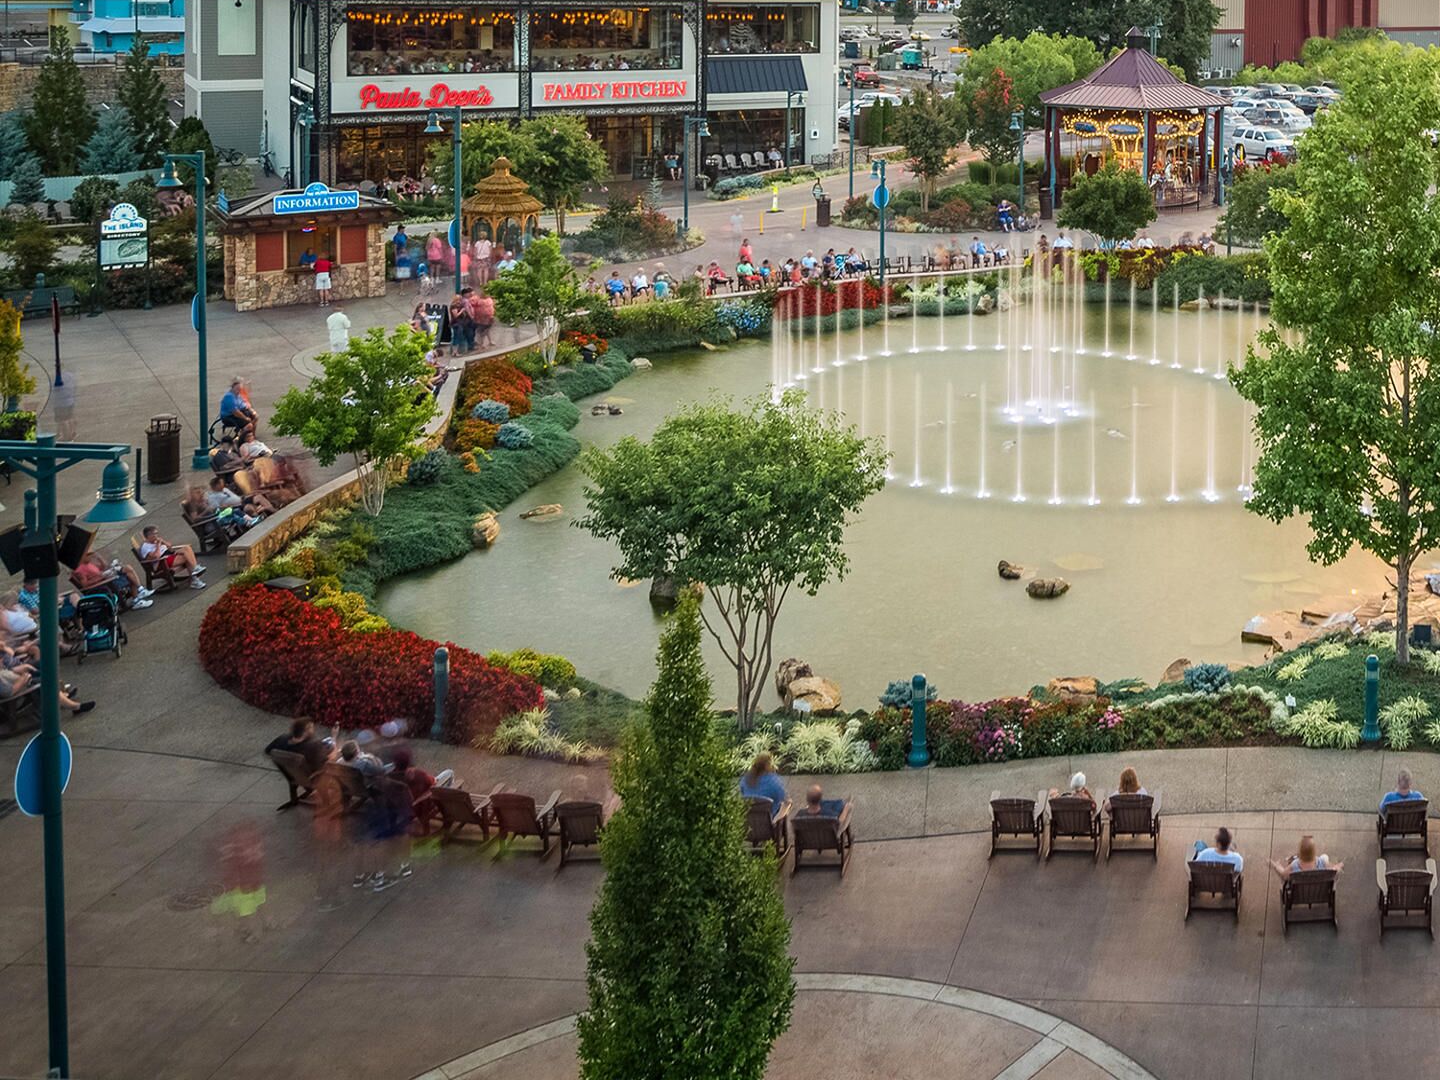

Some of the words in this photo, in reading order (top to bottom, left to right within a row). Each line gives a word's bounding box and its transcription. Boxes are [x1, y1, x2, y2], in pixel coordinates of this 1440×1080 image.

[360, 84, 422, 109] Paula
[424, 83, 494, 108] Deen's
[543, 82, 608, 100] FAMILY
[611, 80, 687, 98] KITCHEN
[277, 195, 356, 209] INFORMATION
[119, 222, 144, 230] ISLAND
